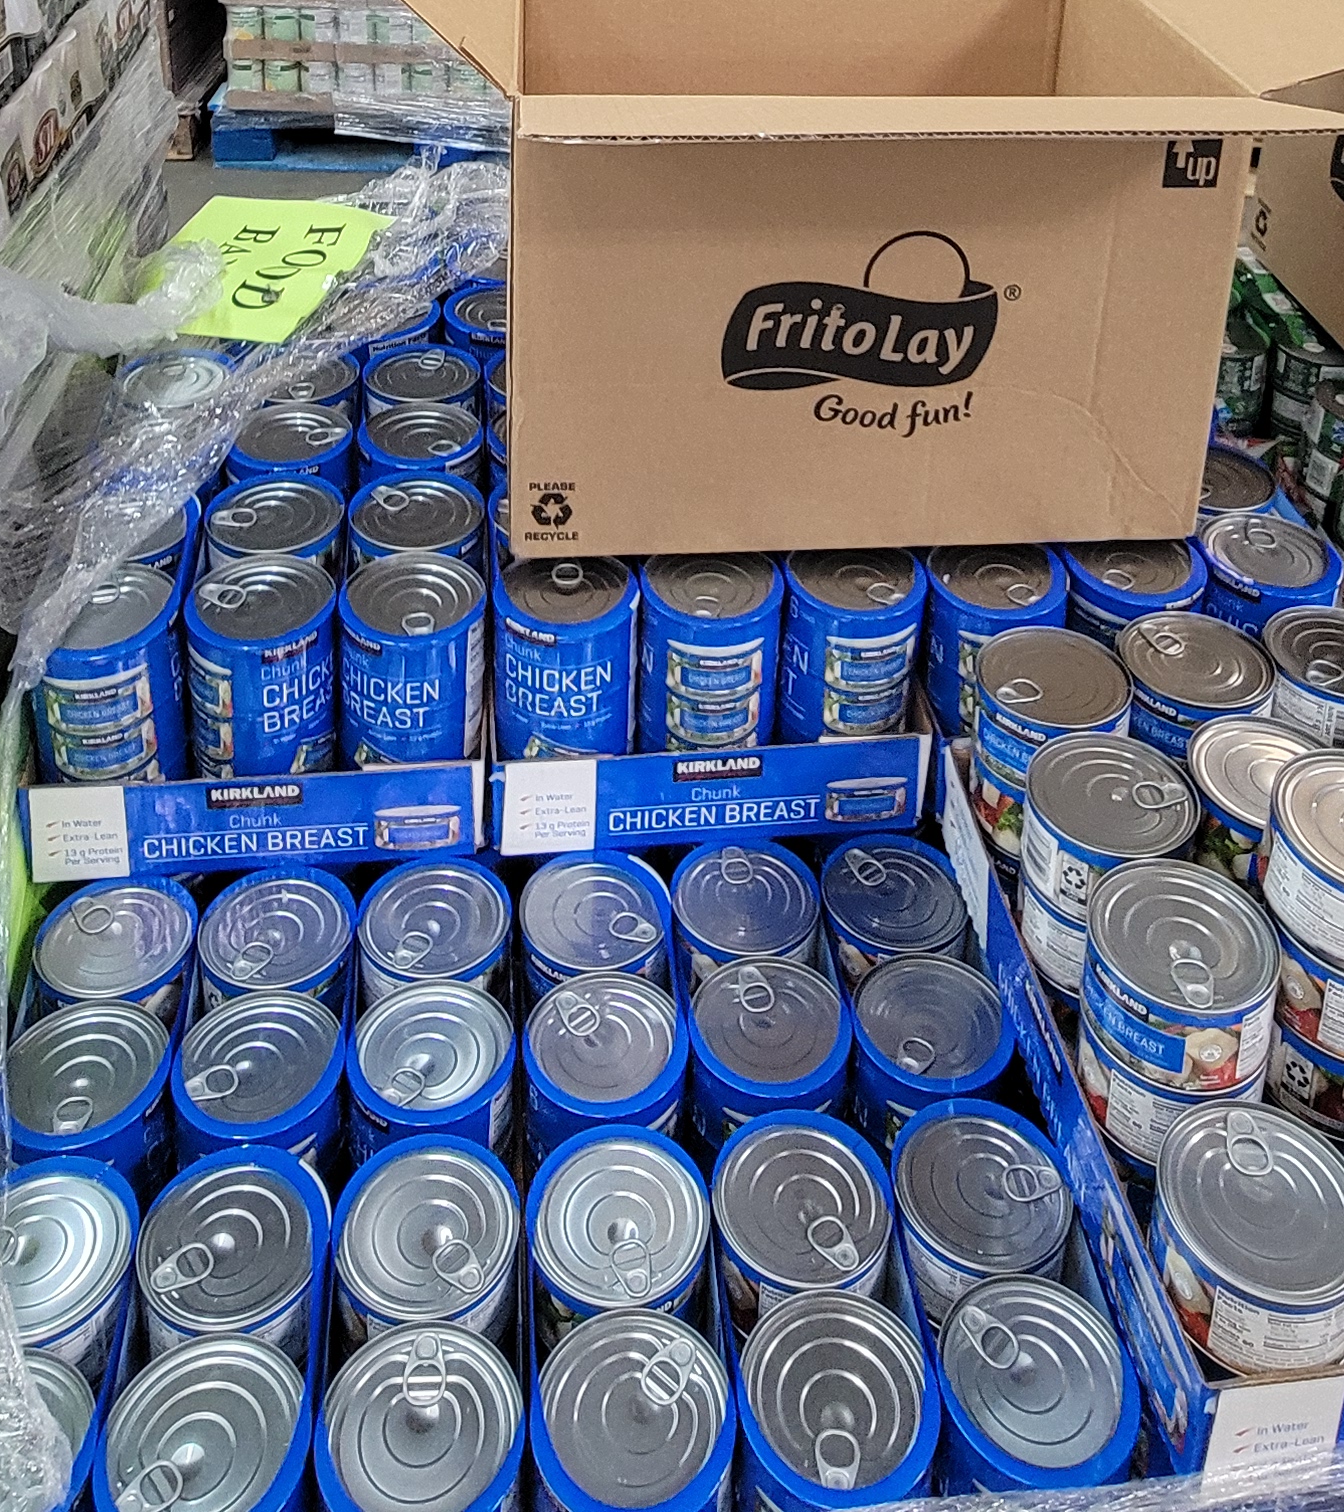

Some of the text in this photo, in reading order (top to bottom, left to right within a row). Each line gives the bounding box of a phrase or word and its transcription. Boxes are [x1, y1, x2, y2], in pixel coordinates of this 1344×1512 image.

[1186, 150, 1217, 186] up
[232, 223, 347, 310] FOOD
[745, 297, 974, 374] FritoLay
[813, 391, 973, 438] Good fun!
[529, 481, 576, 492] PLEASE
[525, 530, 579, 542] RECYCLE
[263, 631, 318, 660] KIRKLAND
[259, 656, 307, 680] Chunk
[505, 654, 613, 693] CHICKEN
[505, 684, 602, 719] BREAST
[995, 712, 1048, 743] KIRKLAND
[676, 757, 761, 776] KIRKLAND
[210, 784, 301, 803] KIRKLAND
[690, 785, 741, 801] Chunk
[229, 812, 283, 829] Chunk
[534, 803, 588, 816] Extra-Lean
[608, 798, 822, 832] CHICKEN BREAST
[60, 817, 103, 829] In Water
[63, 847, 76, 858] 13
[85, 845, 124, 858] Protein
[143, 825, 370, 859] CHICKEN BREAST
[1117, 1021, 1166, 1056] BREAST
[1257, 1420, 1310, 1435] In Water
